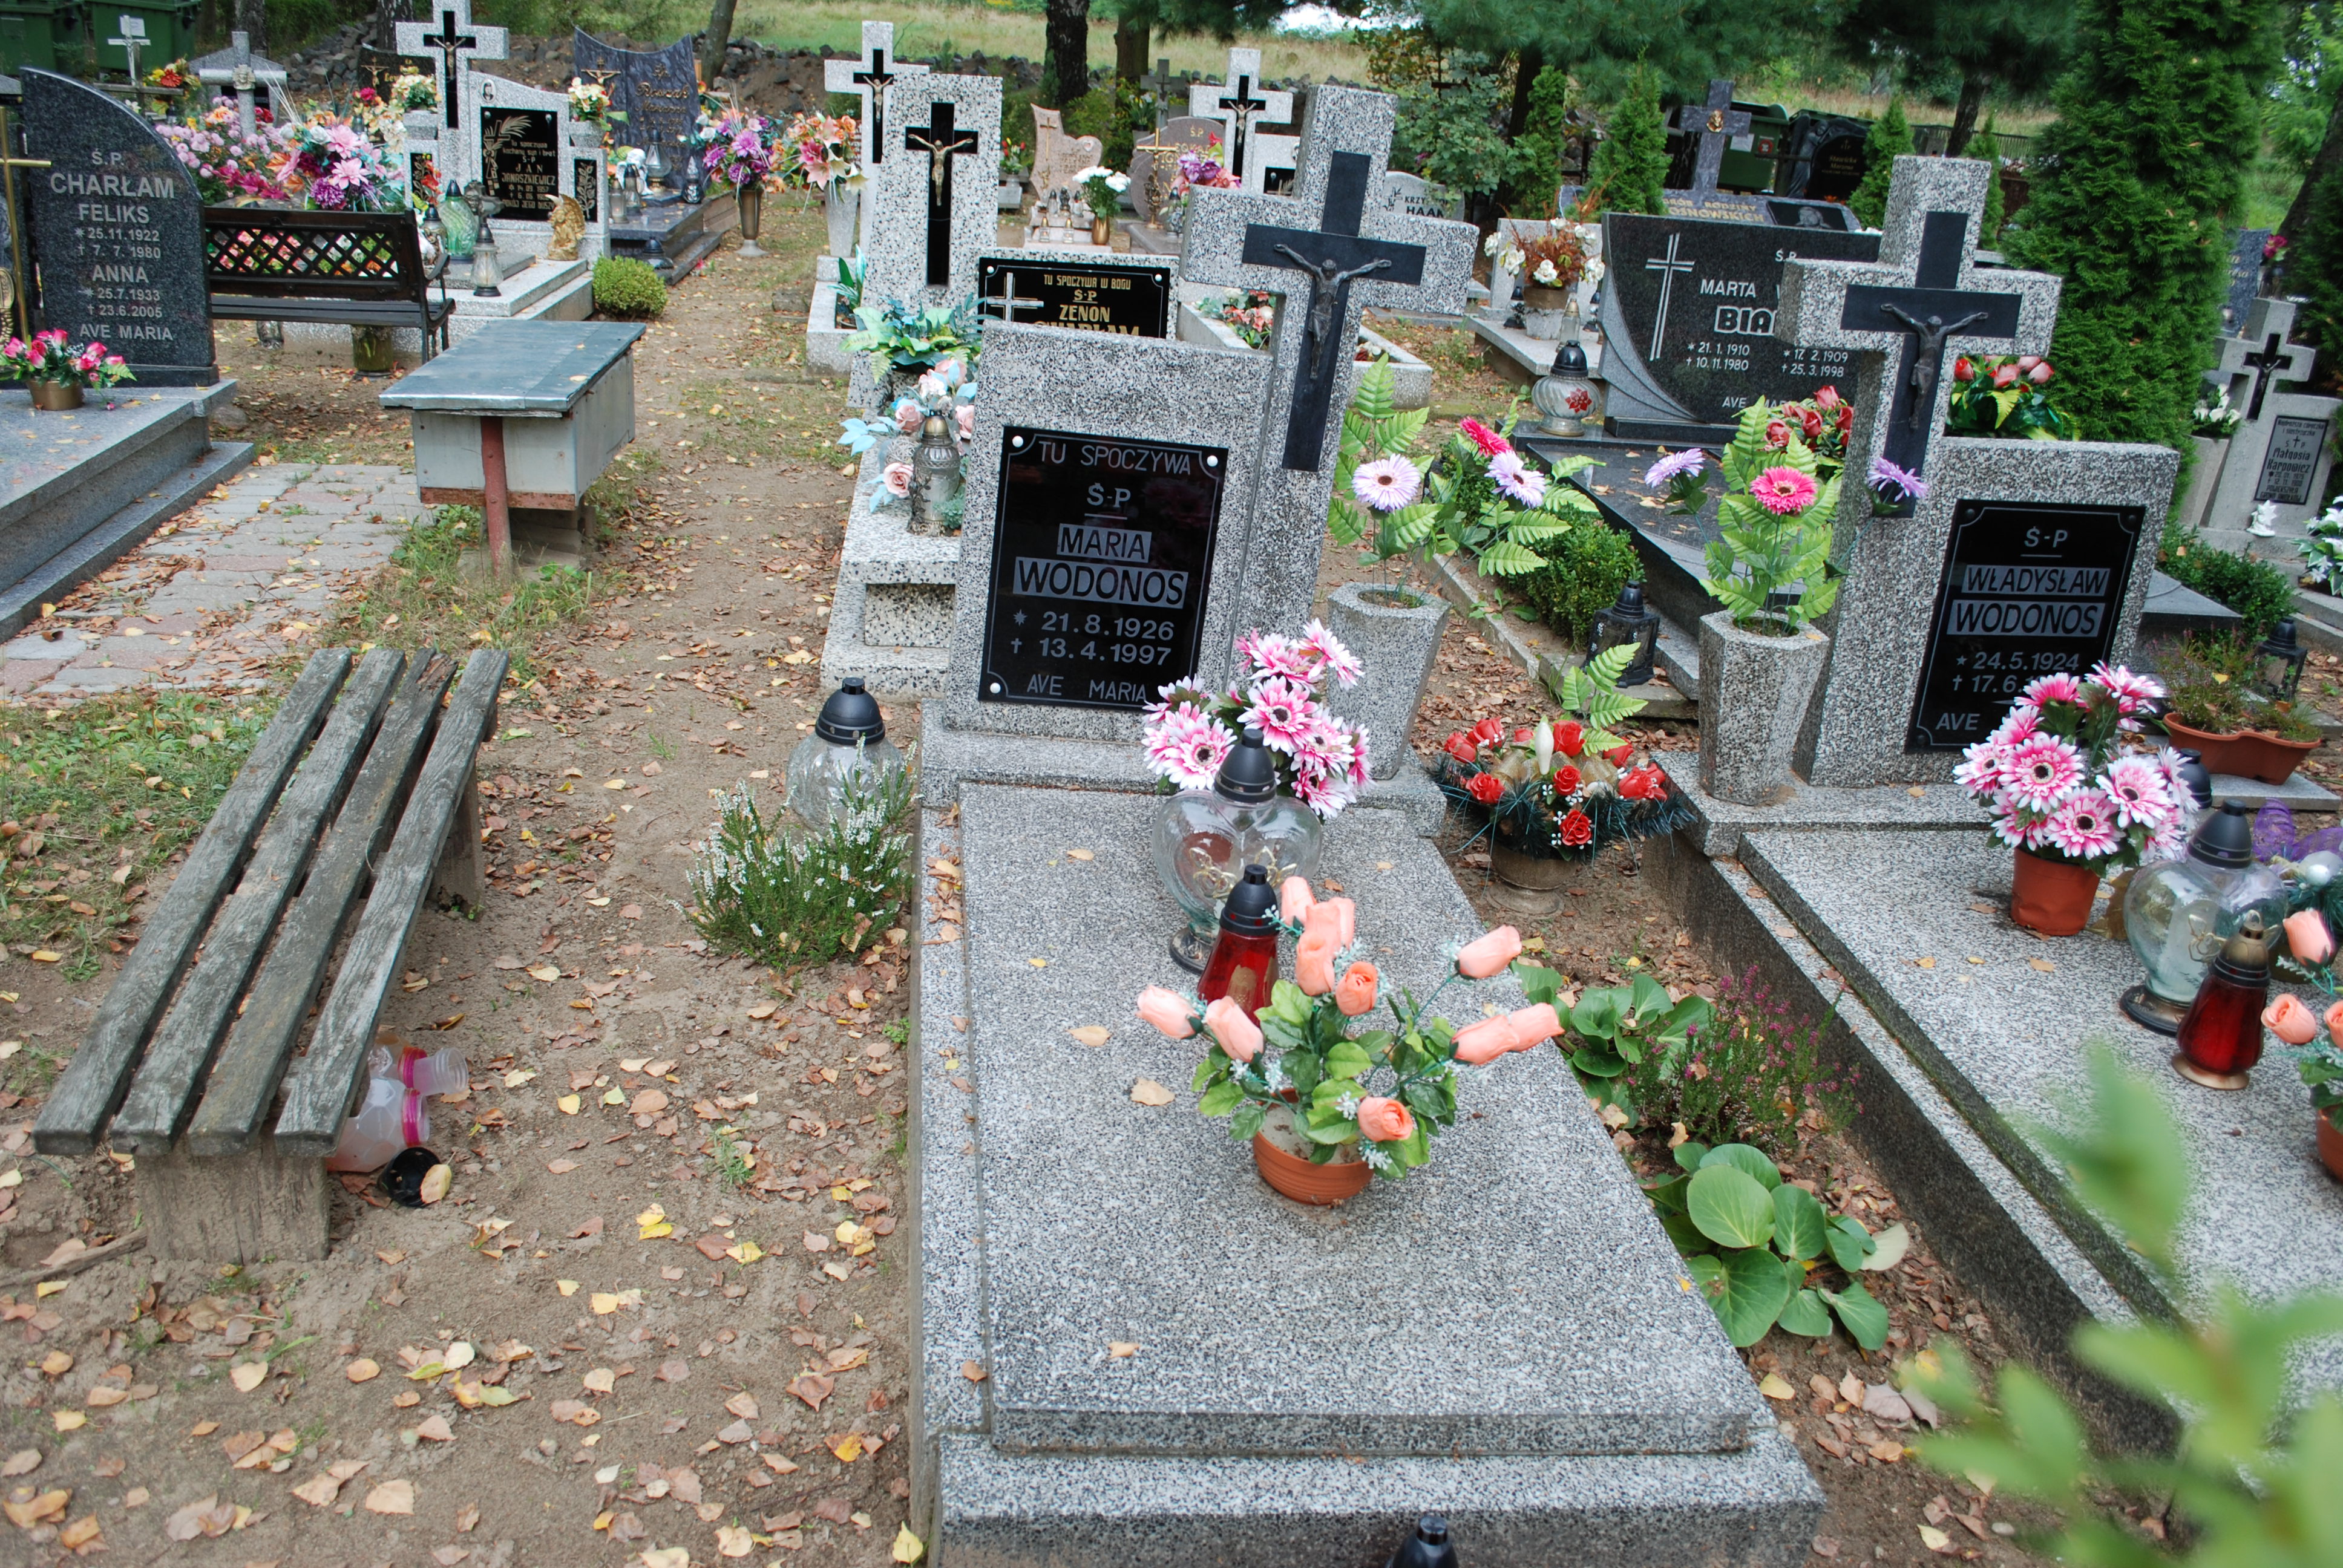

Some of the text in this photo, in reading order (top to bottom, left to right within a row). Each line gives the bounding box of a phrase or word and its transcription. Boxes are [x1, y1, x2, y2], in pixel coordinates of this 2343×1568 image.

[50, 172, 175, 198] CHARŁAM
[502, 172, 556, 185] JANASZKIEWICZ
[78, 203, 149, 223] FELIKS
[88, 227, 160, 242] 25.11.1922
[92, 265, 149, 283] ANNA
[1044, 274, 1132, 290] TU SPOCZYWA W BOGU
[97, 287, 160, 301] 25.7.1933
[1700, 279, 1756, 298] MARTA
[99, 305, 163, 318] 23.6.2005
[1059, 304, 1111, 322] ZENON
[79, 324, 174, 341] AVE MARIA
[1722, 396, 1747, 408] AVE
[1038, 441, 1191, 475] TU SPOCZYWA
[2273, 448, 2310, 460] Małgosia
[2267, 459, 2311, 474] Karpowicz
[1059, 526, 1145, 560] MARIA
[1018, 560, 1184, 605] WODONOS
[1968, 567, 2108, 594] WŁADYSŁAW
[1955, 603, 2098, 635] WODONOS
[1972, 652, 2080, 671] 24.5.1924
[1027, 673, 1147, 702] AVE MARIA
[1936, 713, 1981, 730] AVE
